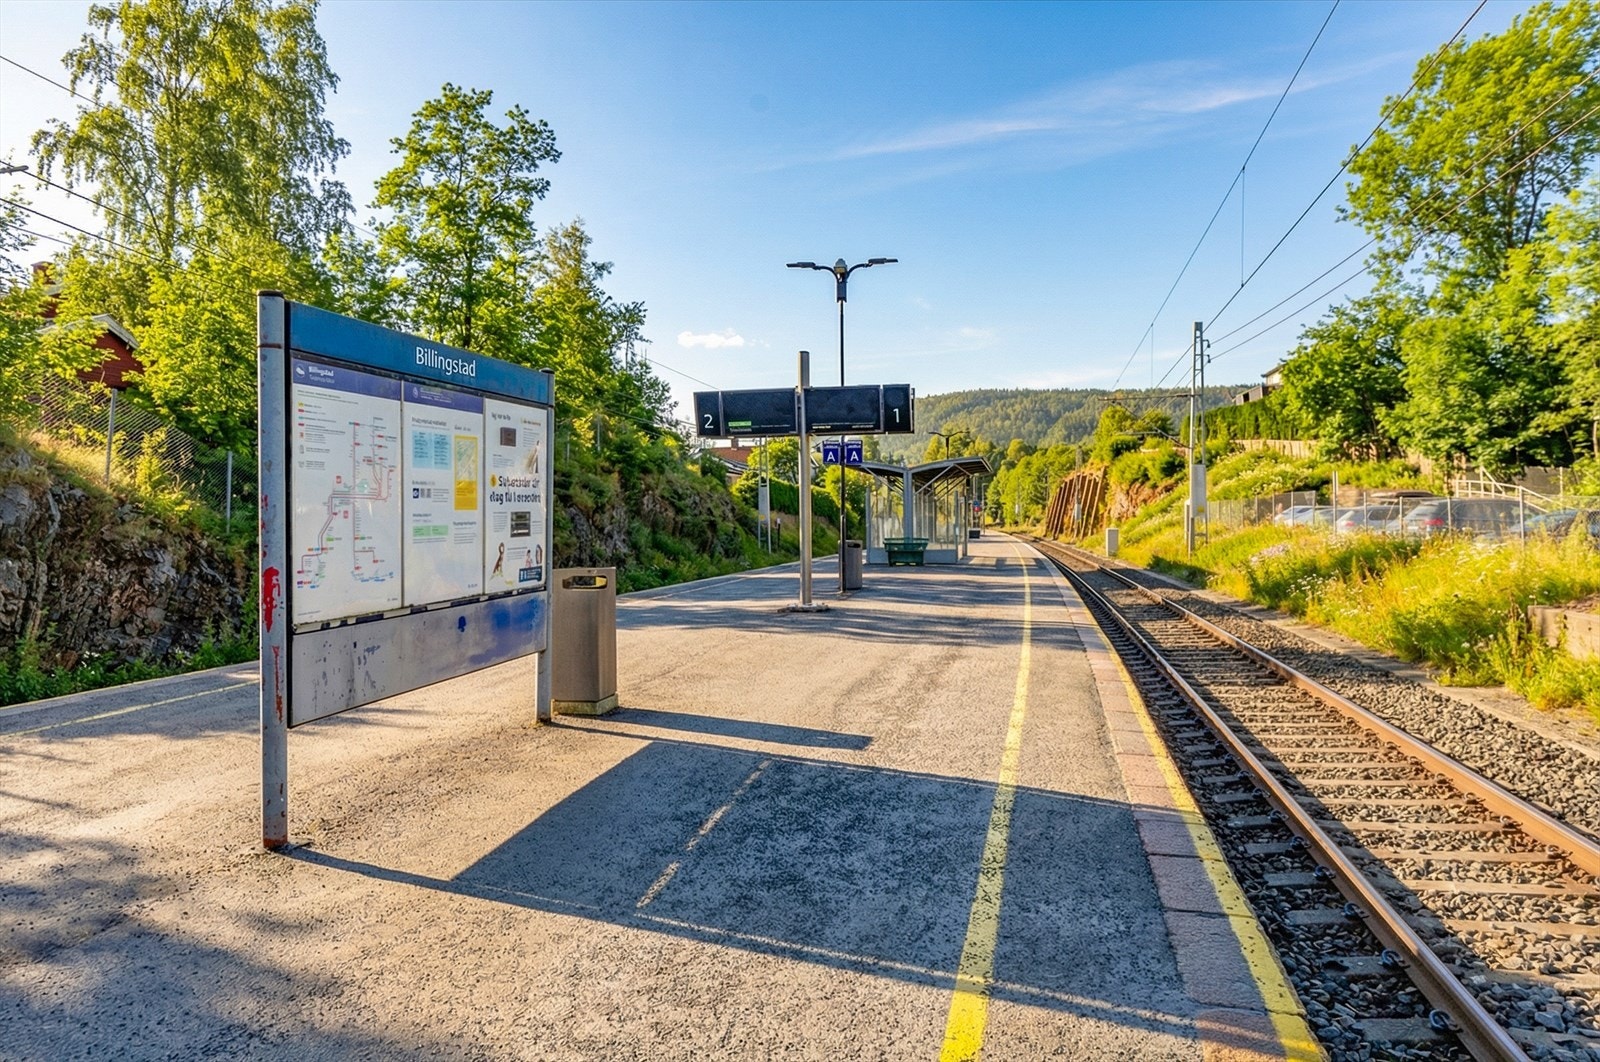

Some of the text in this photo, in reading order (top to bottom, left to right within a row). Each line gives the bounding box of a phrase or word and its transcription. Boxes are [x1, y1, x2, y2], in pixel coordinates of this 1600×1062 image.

[416, 346, 476, 377] Billingstad
[703, 413, 714, 429] 2
[893, 408, 900, 423] 1
[827, 451, 836, 462] A
[850, 450, 859, 462] A
